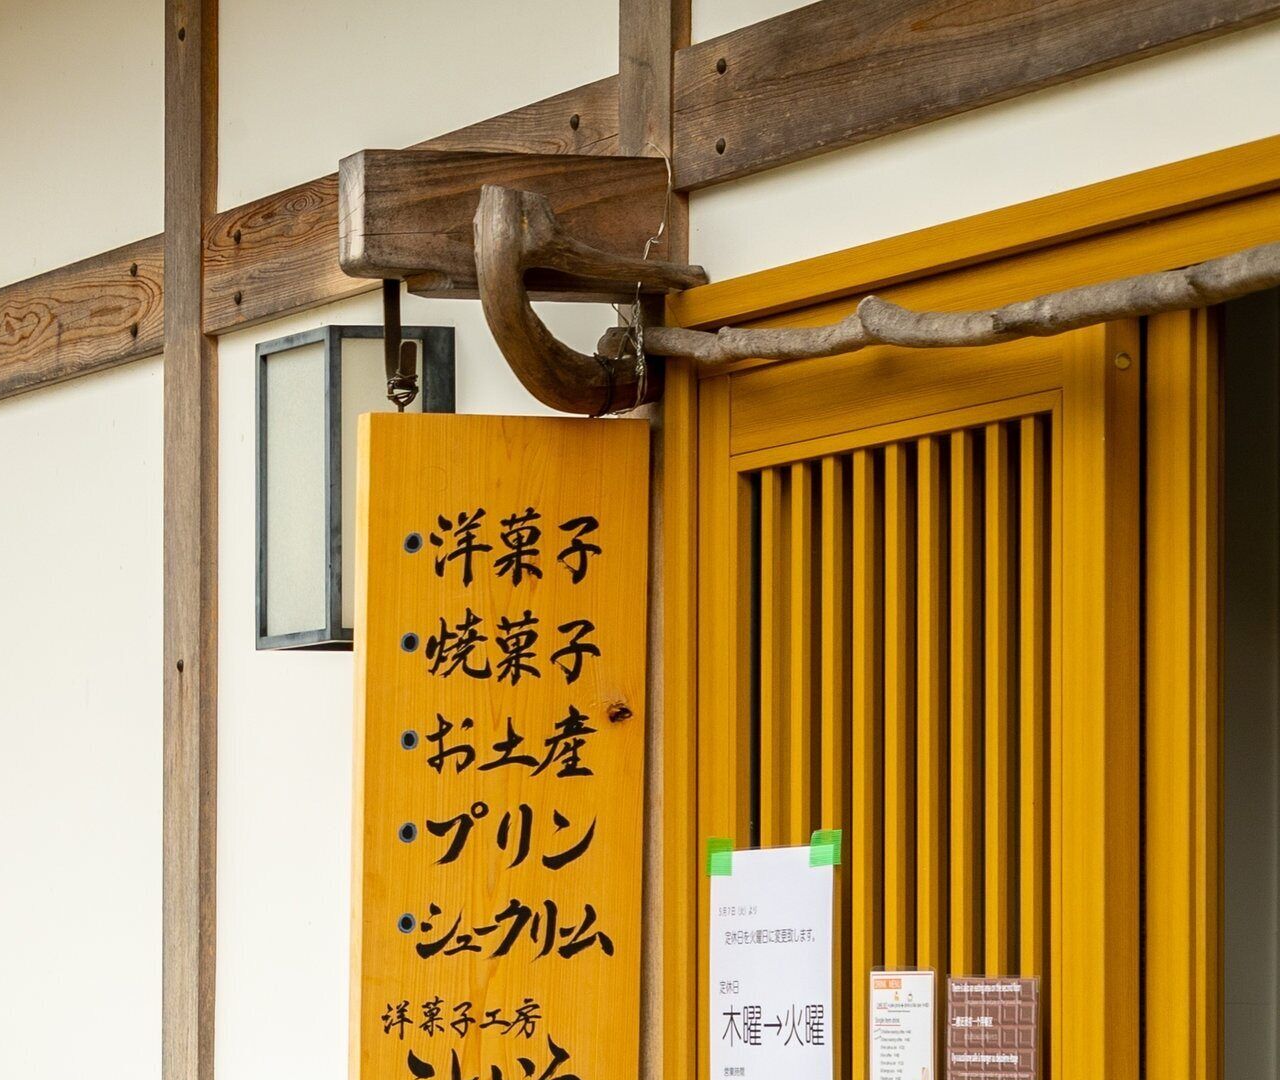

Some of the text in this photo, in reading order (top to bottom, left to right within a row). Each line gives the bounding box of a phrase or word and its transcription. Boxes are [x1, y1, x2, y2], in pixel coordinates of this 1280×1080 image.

[429, 507, 603, 588] 洋菓子
[425, 608, 602, 685] 焼菓子
[425, 704, 599, 779] お土産
[425, 802, 597, 873] プリン
[415, 898, 615, 964] シュークリーム
[381, 998, 544, 1041] 洋菓子工房
